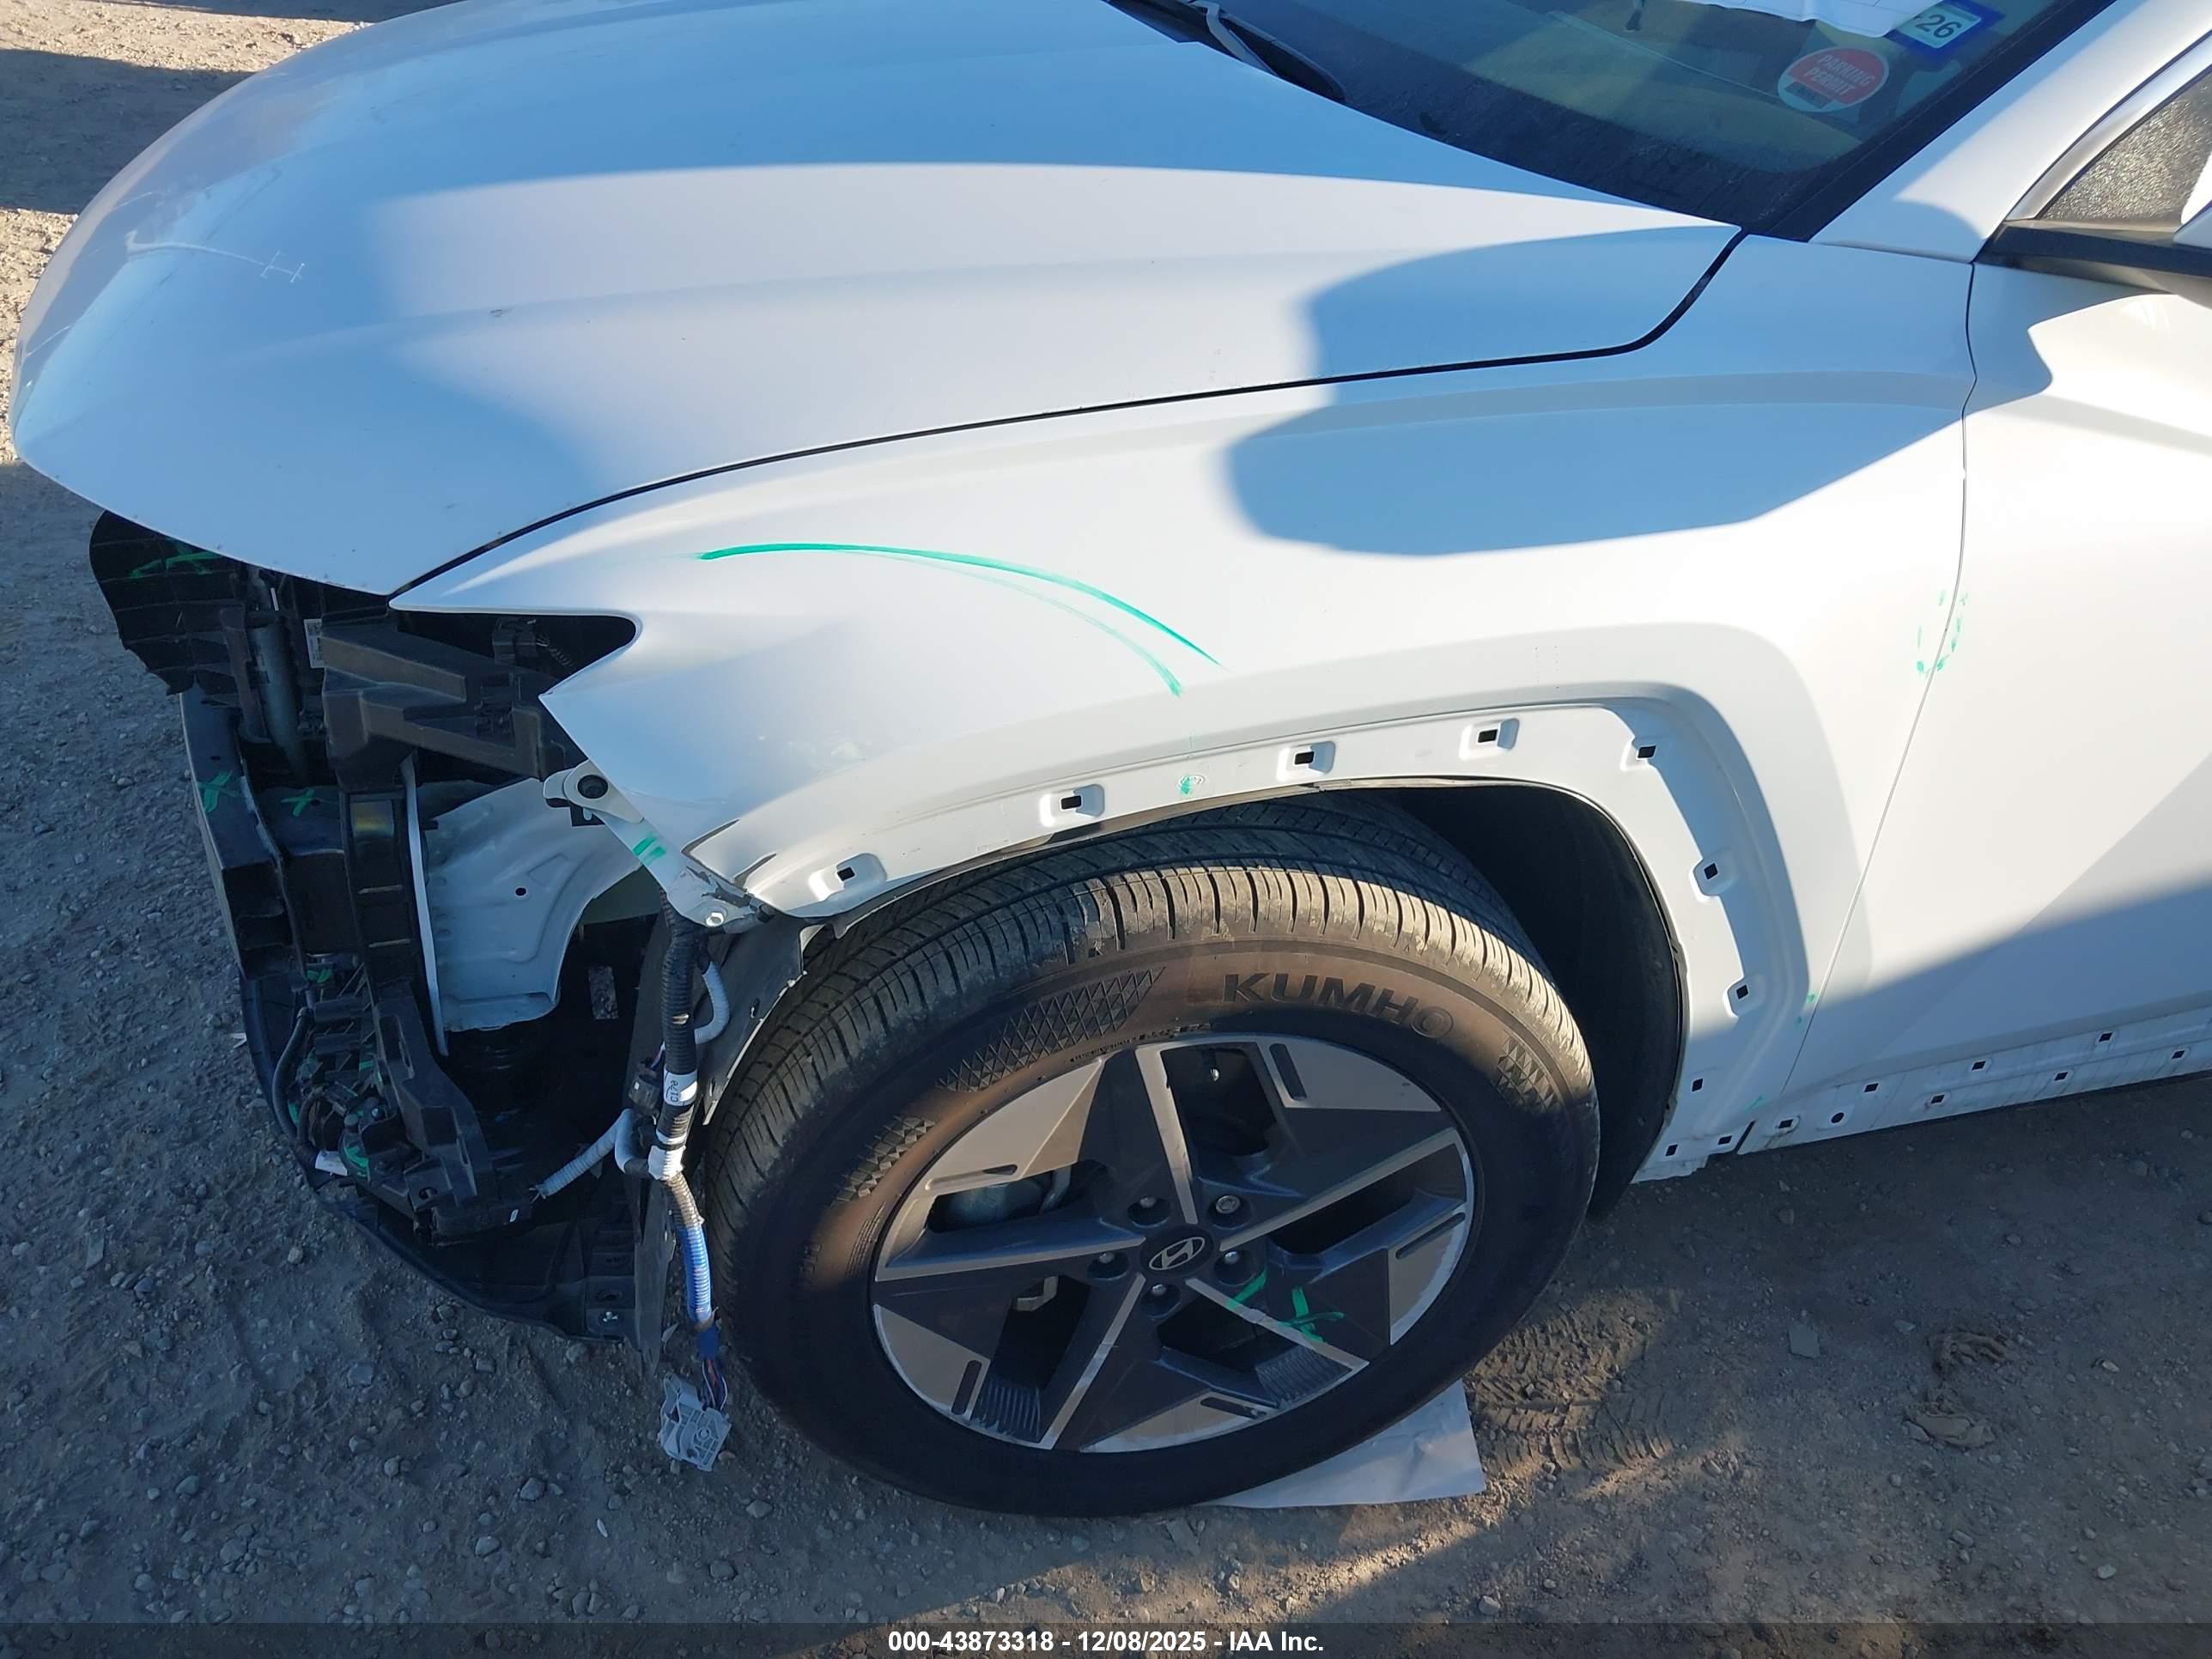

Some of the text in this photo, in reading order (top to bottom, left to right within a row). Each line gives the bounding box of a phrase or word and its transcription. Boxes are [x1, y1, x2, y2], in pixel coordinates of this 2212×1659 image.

[1803, 66, 1857, 98] PERMIT
[1817, 53, 1876, 86] PARKING
[1222, 972, 1455, 1039] KUMHO
